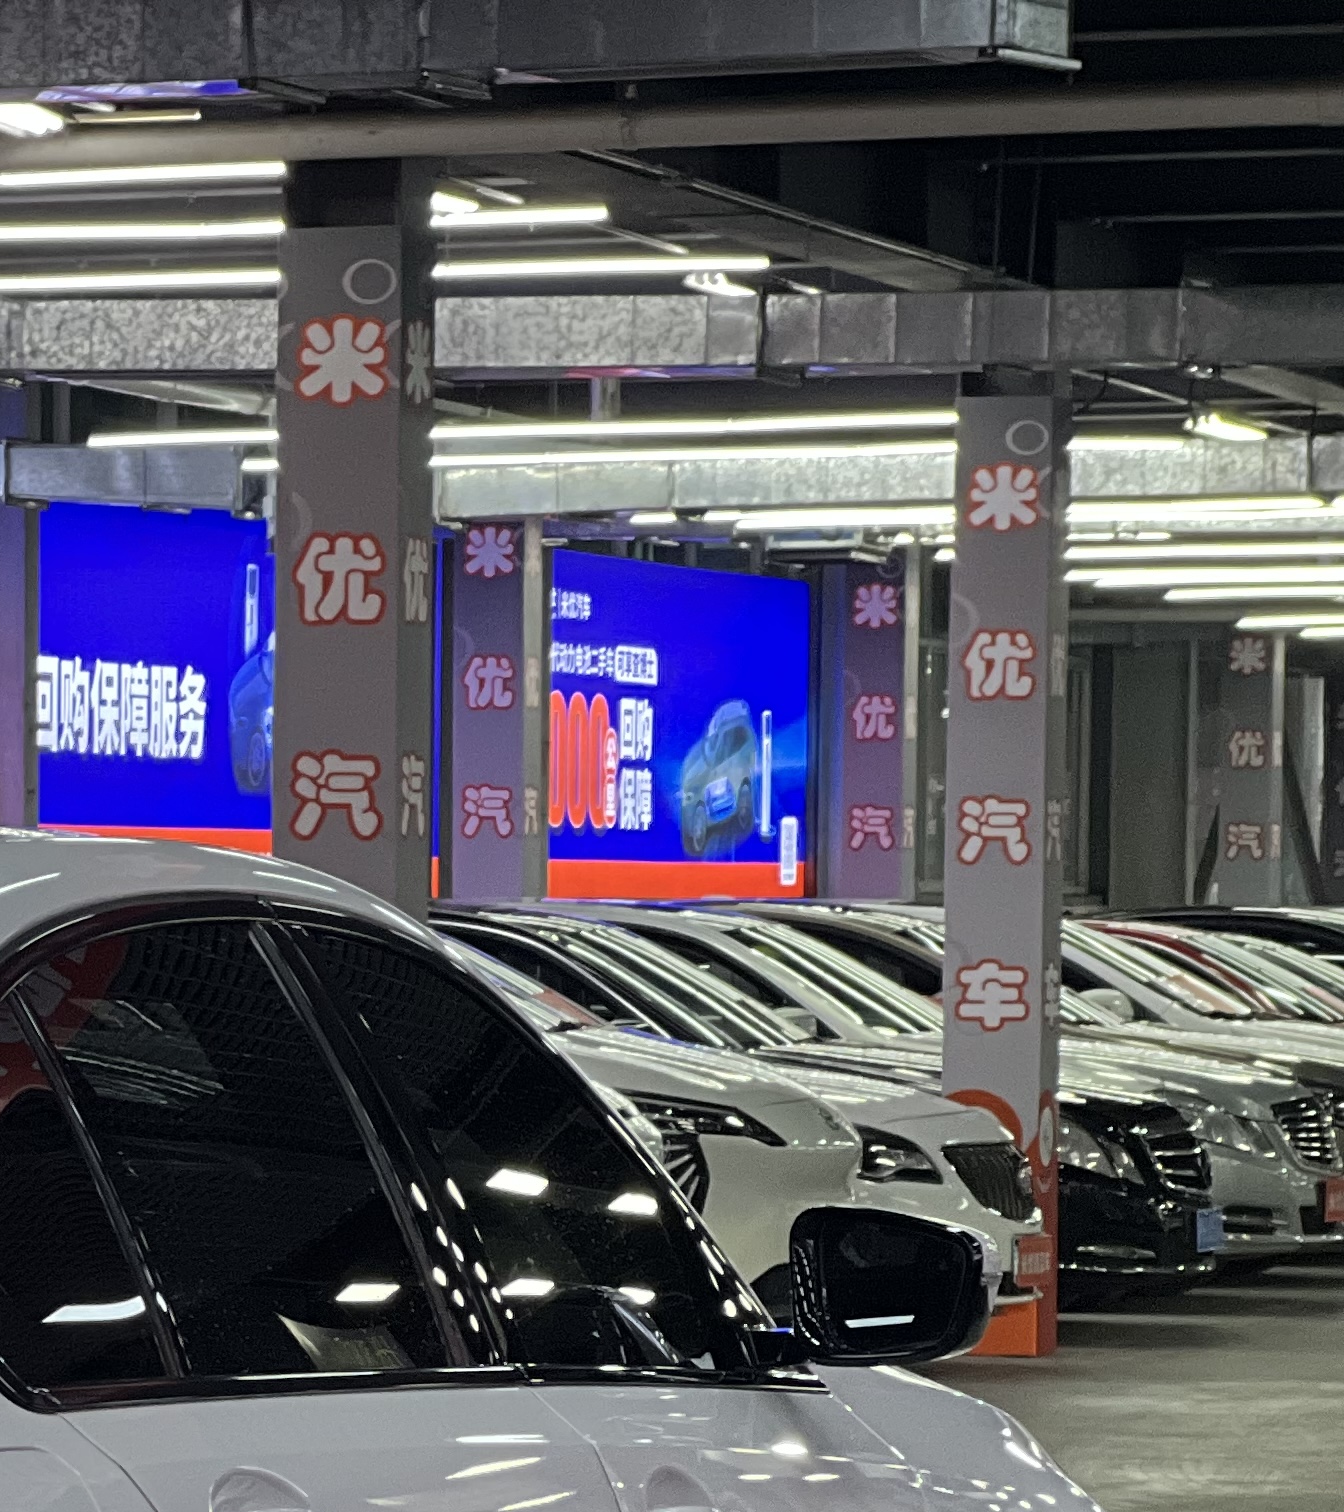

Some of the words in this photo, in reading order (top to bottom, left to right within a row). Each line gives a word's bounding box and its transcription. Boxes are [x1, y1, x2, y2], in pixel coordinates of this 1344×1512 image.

[36, 654, 208, 760] 回购保障服务
[957, 463, 1039, 1031] 米优汽车
